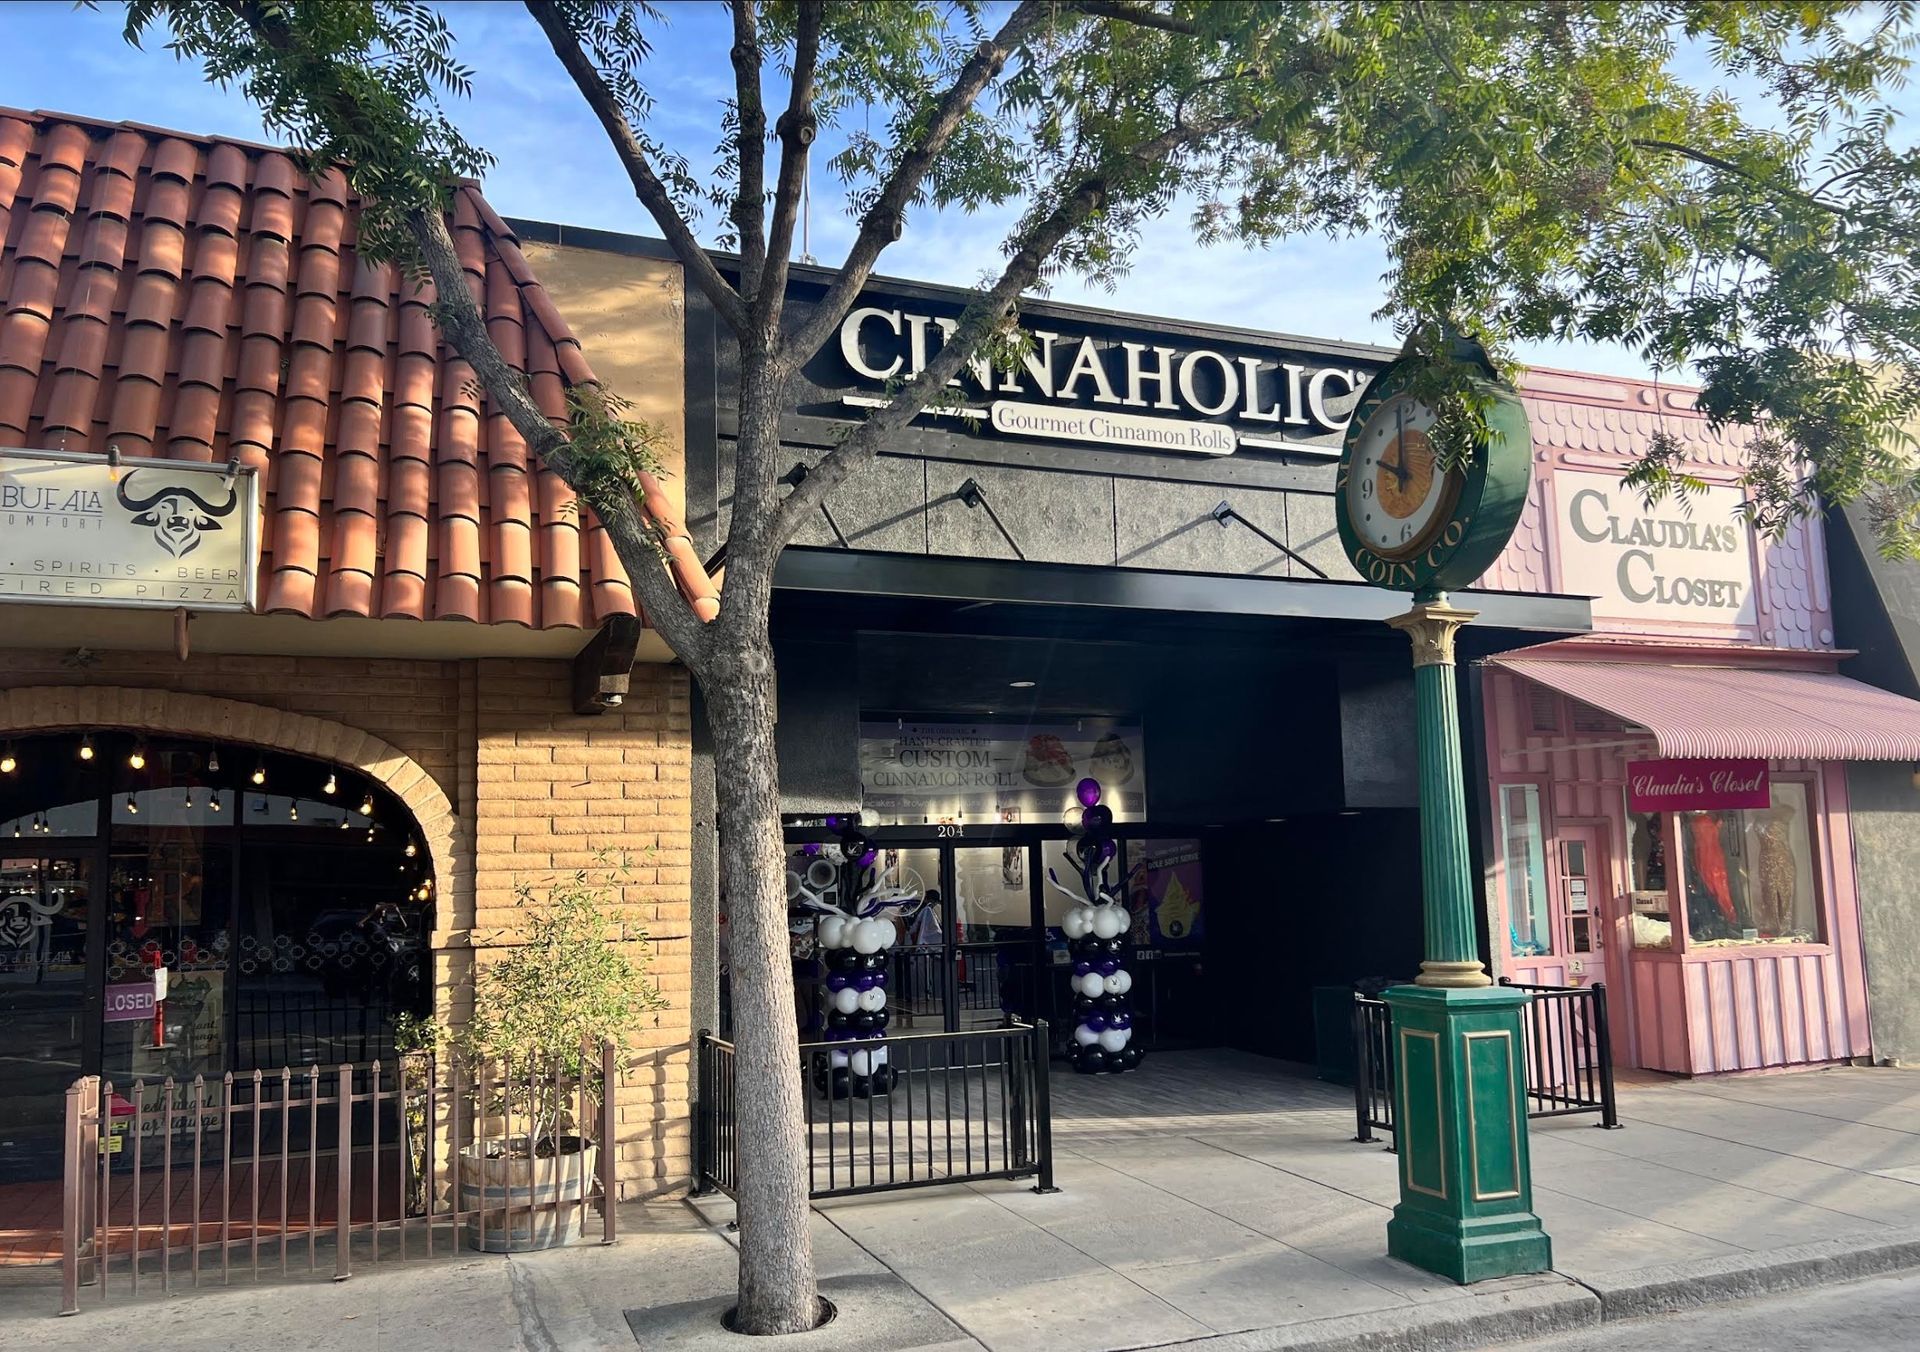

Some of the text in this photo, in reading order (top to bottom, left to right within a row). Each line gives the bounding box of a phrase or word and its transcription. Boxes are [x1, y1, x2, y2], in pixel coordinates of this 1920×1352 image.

[998, 407, 1231, 450] Gourmet Cinnamon Rolls
[2, 485, 103, 513] BUFALA
[1361, 478, 1373, 500] 9
[9, 513, 102, 530] OMFORT
[1400, 522, 1412, 543] 6
[33, 559, 238, 581] SPIRITS BEER
[1355, 548, 1417, 586] COIN
[136, 584, 238, 600] PIZZA
[900, 750, 990, 768] CUSTOM
[873, 771, 1018, 787] CINNAMON ROLL
[1632, 770, 1763, 797] Claudia's Closet
[937, 825, 964, 837] 204
[104, 992, 153, 1011] LOSED
